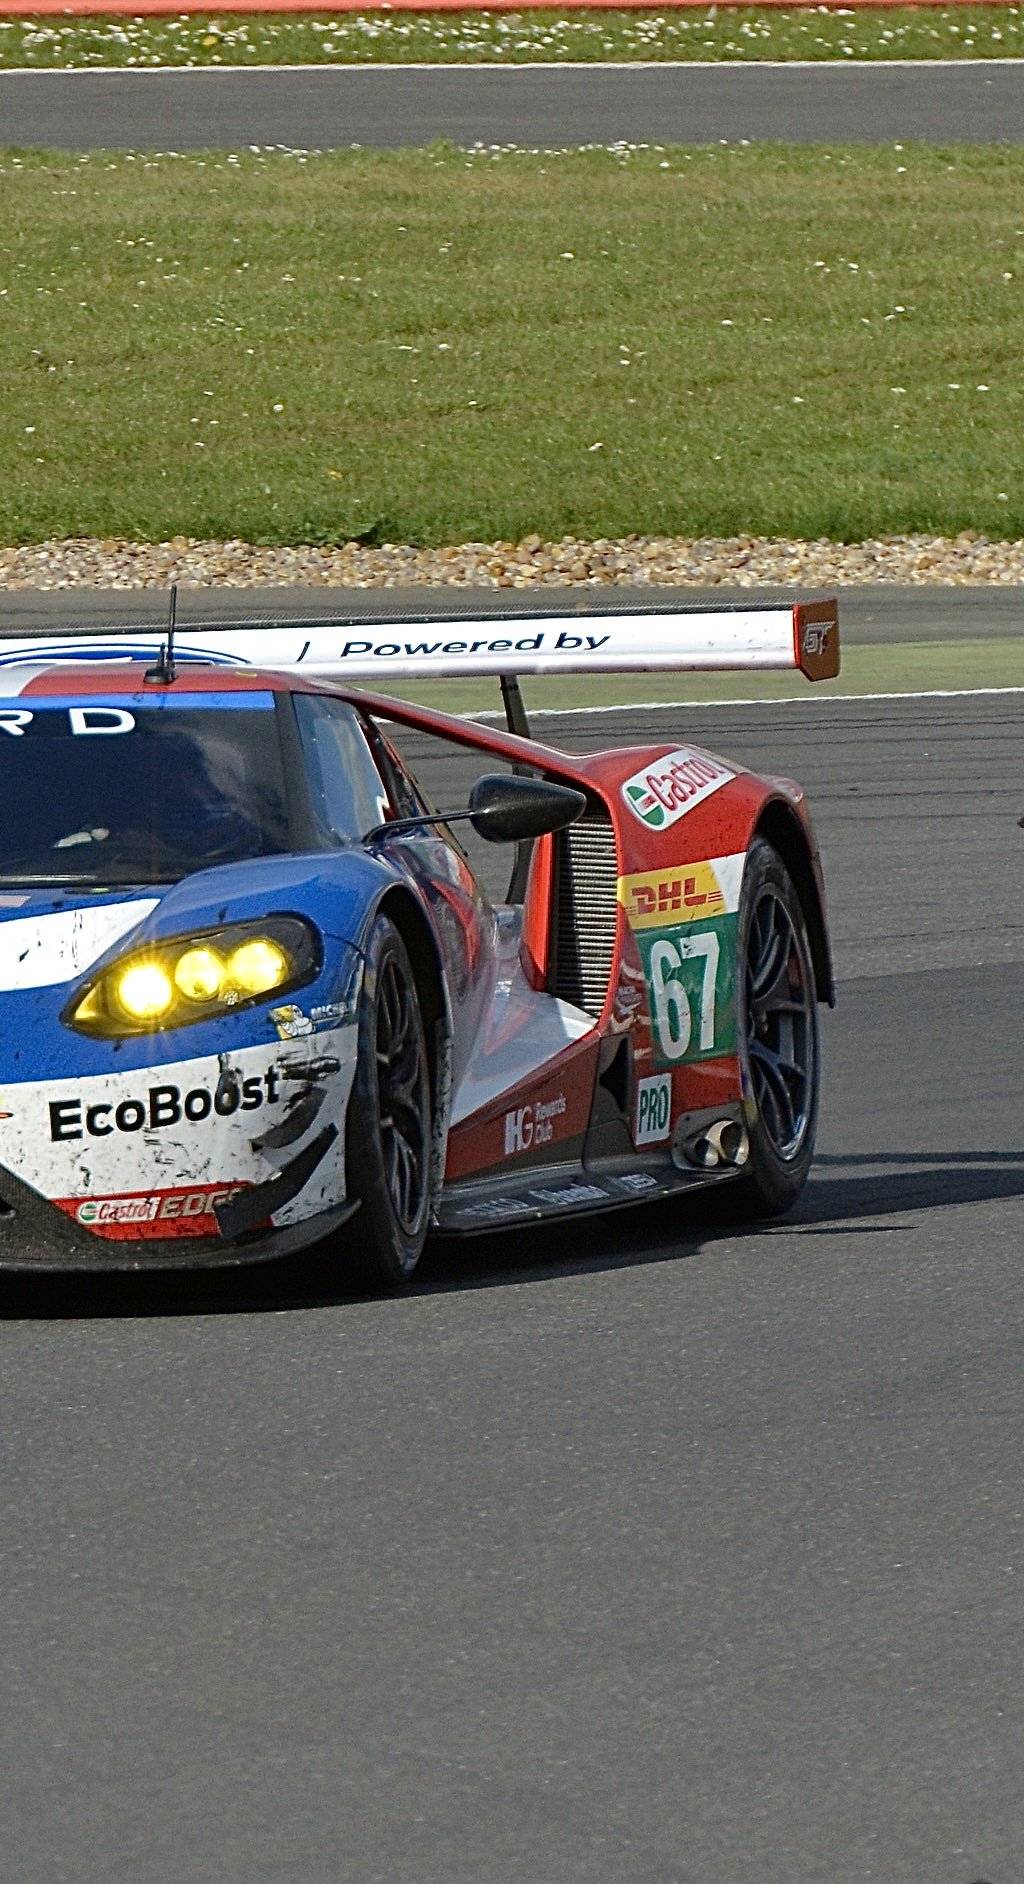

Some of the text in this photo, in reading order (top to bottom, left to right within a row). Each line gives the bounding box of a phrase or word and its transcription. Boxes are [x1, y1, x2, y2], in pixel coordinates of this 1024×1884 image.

[341, 632, 611, 656] Powered by
[646, 752, 726, 811] Castrol
[632, 877, 708, 915] DHL
[650, 932, 720, 1059] 67
[48, 1064, 280, 1143] EcoBoost
[638, 1084, 669, 1134] PRO
[97, 1197, 157, 1220] Castrol
